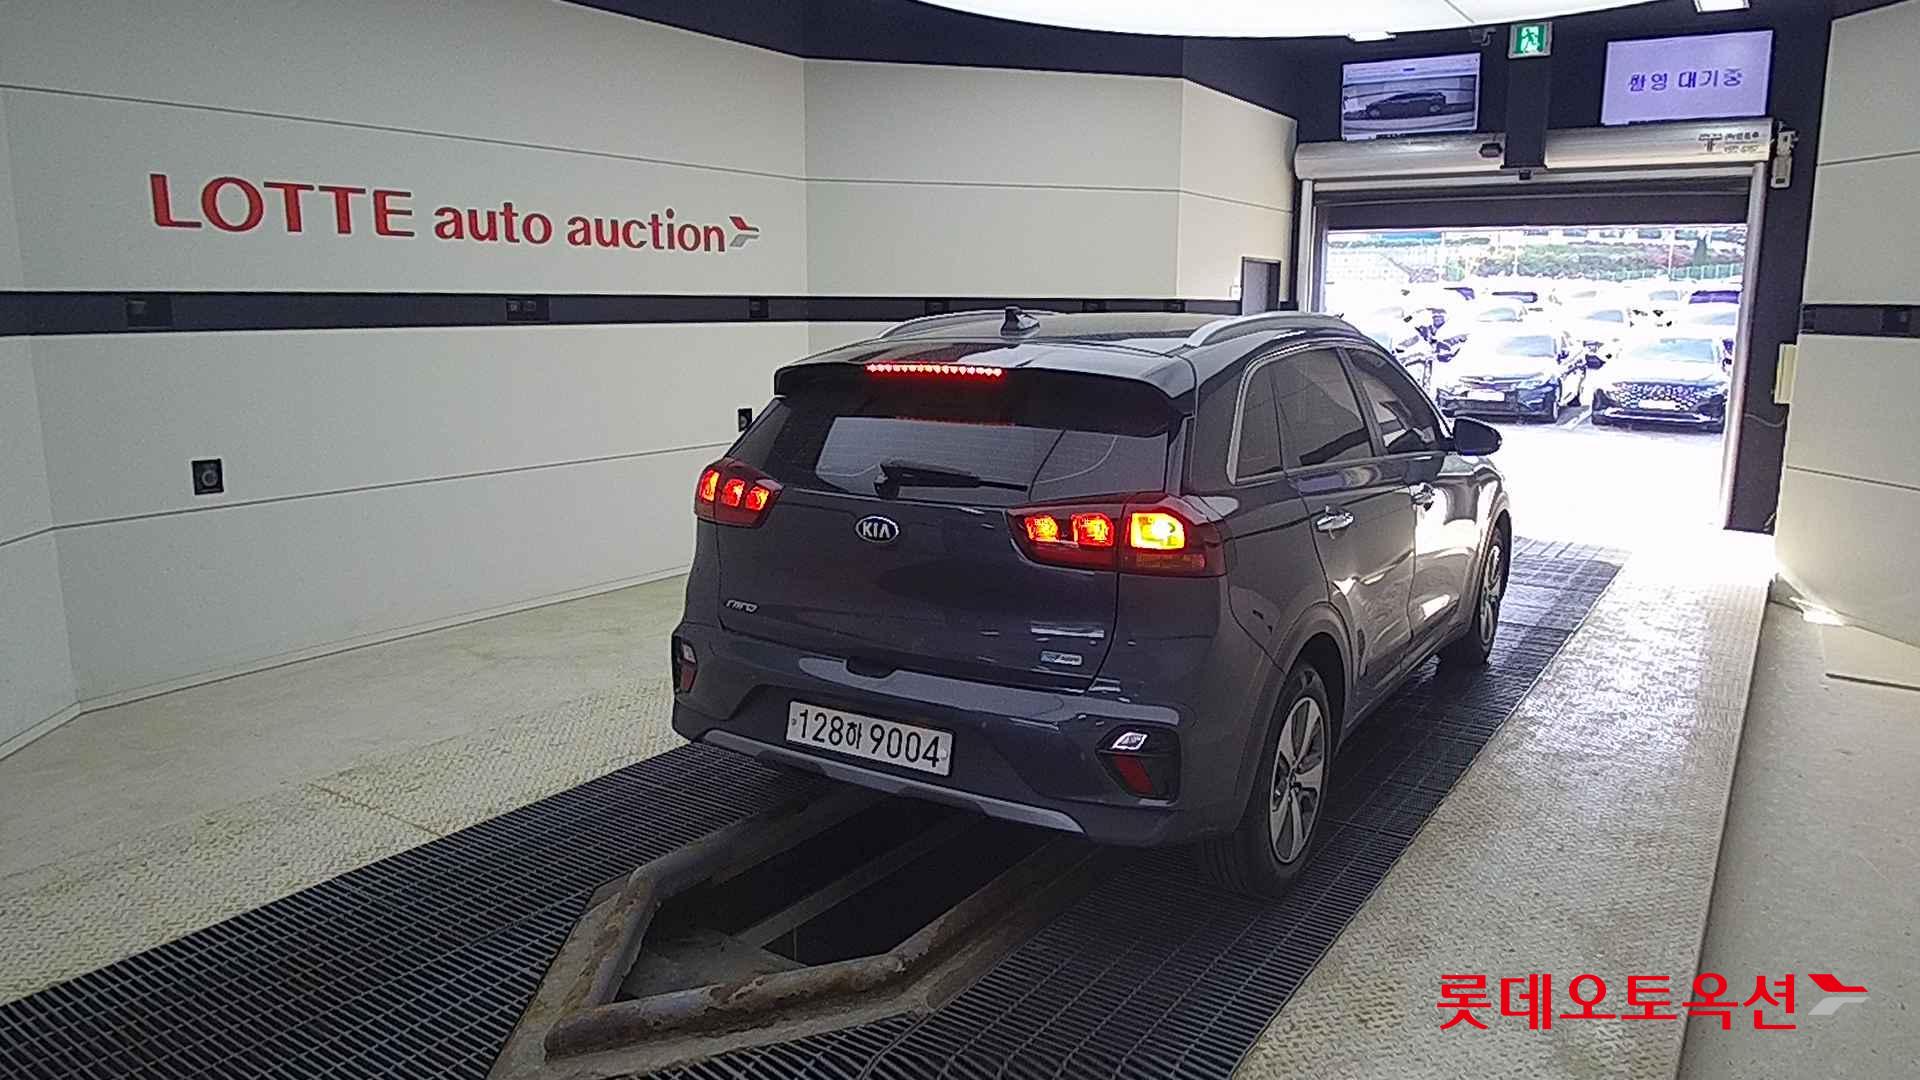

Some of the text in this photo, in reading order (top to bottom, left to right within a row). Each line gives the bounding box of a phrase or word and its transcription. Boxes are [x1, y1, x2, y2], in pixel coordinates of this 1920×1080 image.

[1678, 68, 1742, 88] 대기중
[149, 173, 727, 252] LOTTE auto auction
[862, 521, 891, 538] KIA
[799, 709, 940, 768] 128하 9004
